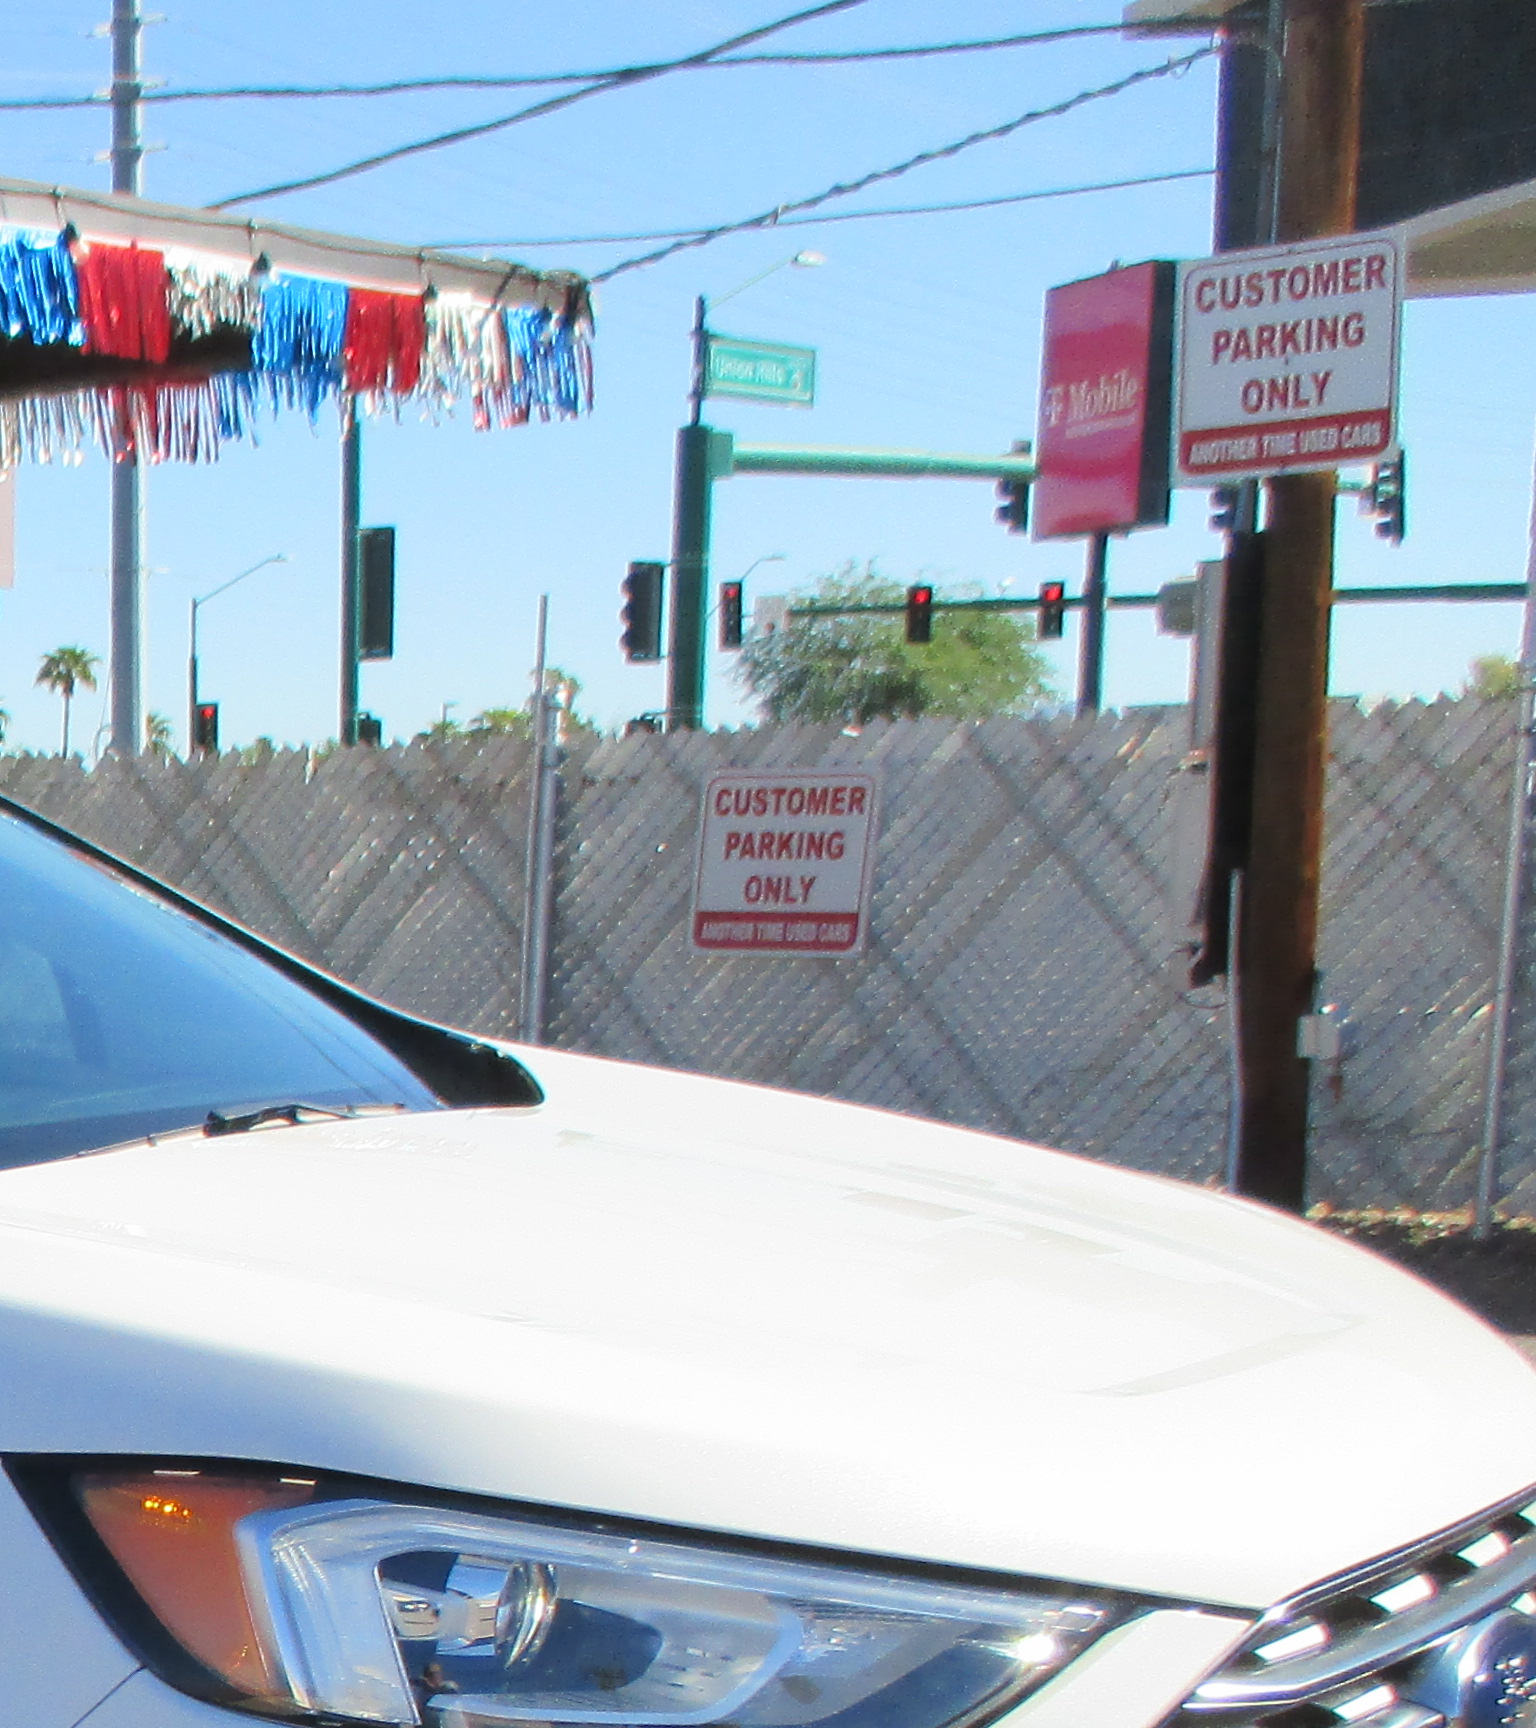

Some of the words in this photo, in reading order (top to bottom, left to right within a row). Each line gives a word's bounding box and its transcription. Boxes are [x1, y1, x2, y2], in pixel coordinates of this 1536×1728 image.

[1194, 254, 1387, 314] CUSTOMER
[1211, 312, 1365, 365] PARKING
[1240, 371, 1332, 415] ONLY
[714, 787, 866, 817] CUSTOMER
[724, 829, 845, 860] PARKING
[744, 874, 816, 904] ONLY
